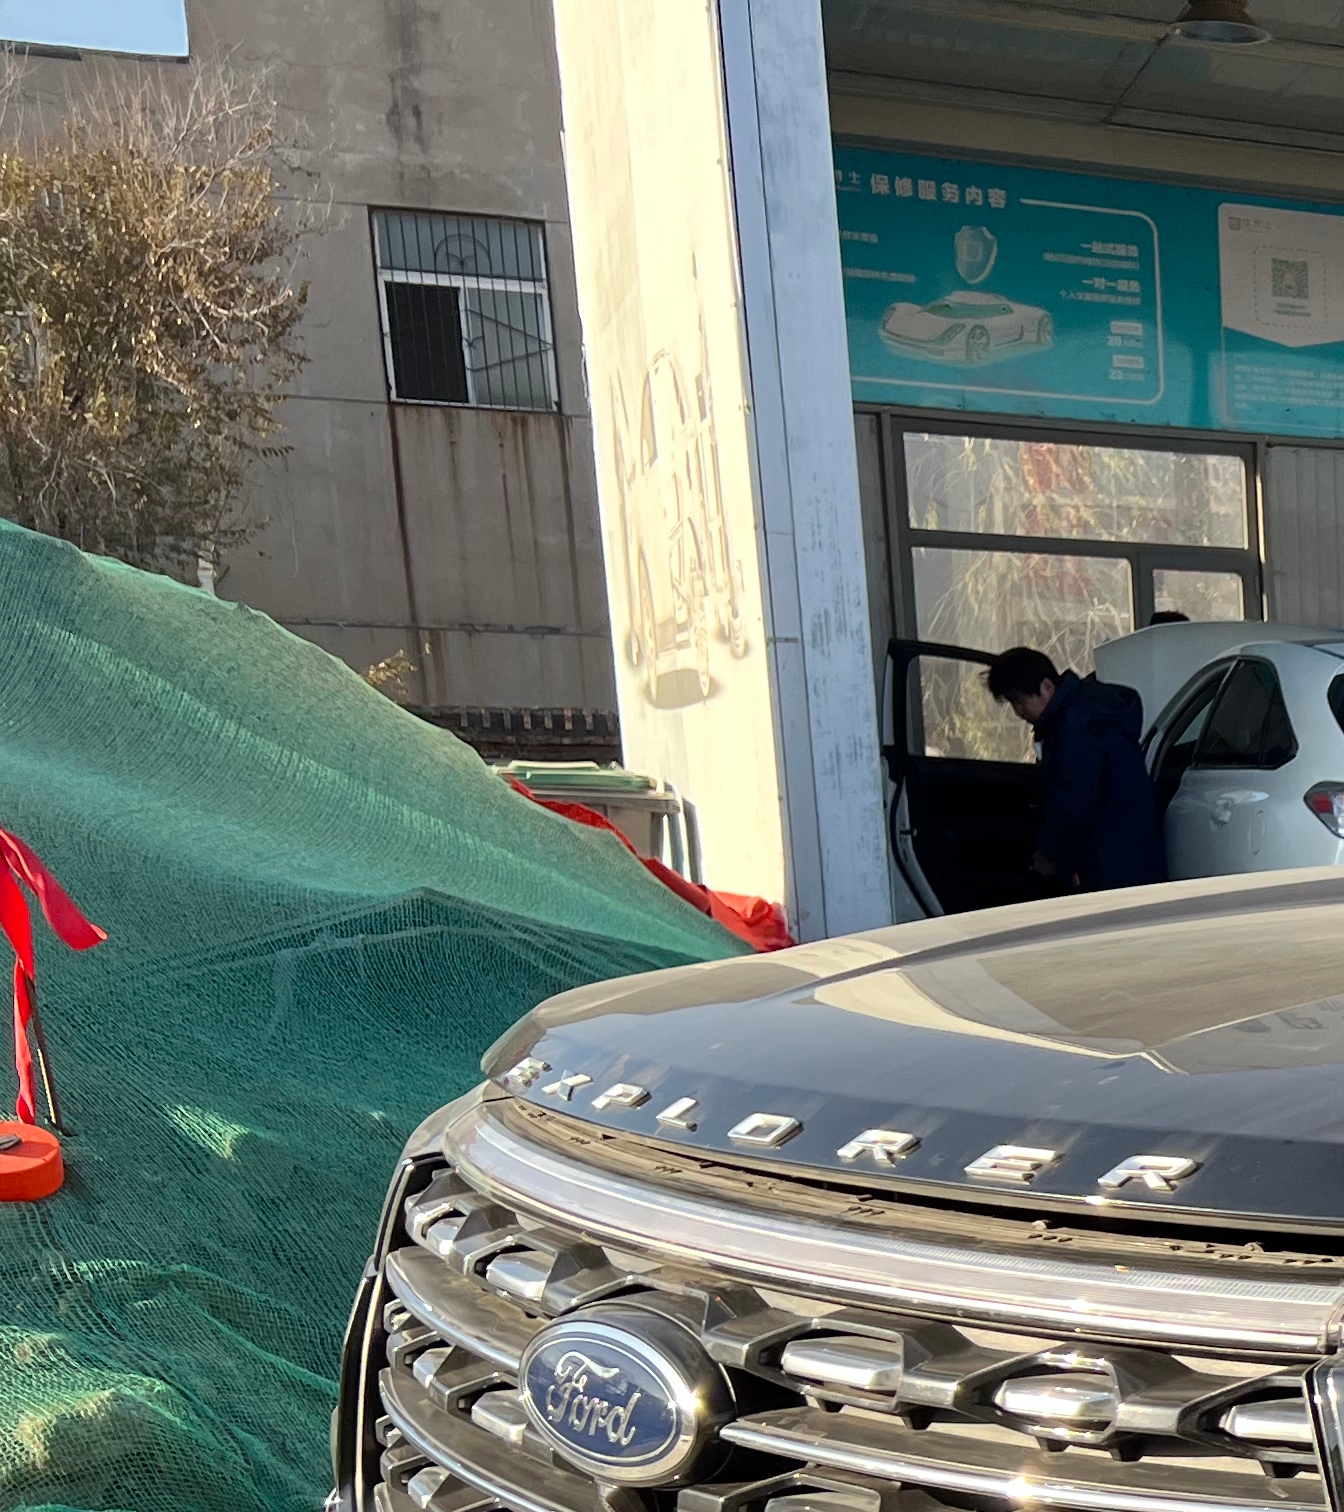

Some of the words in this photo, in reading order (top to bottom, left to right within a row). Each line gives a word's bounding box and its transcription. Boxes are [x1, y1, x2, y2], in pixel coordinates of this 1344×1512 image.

[870, 172, 1008, 209] 保修服务内容
[505, 1056, 1199, 1192] EXPLORER
[544, 1350, 638, 1448] Ford
